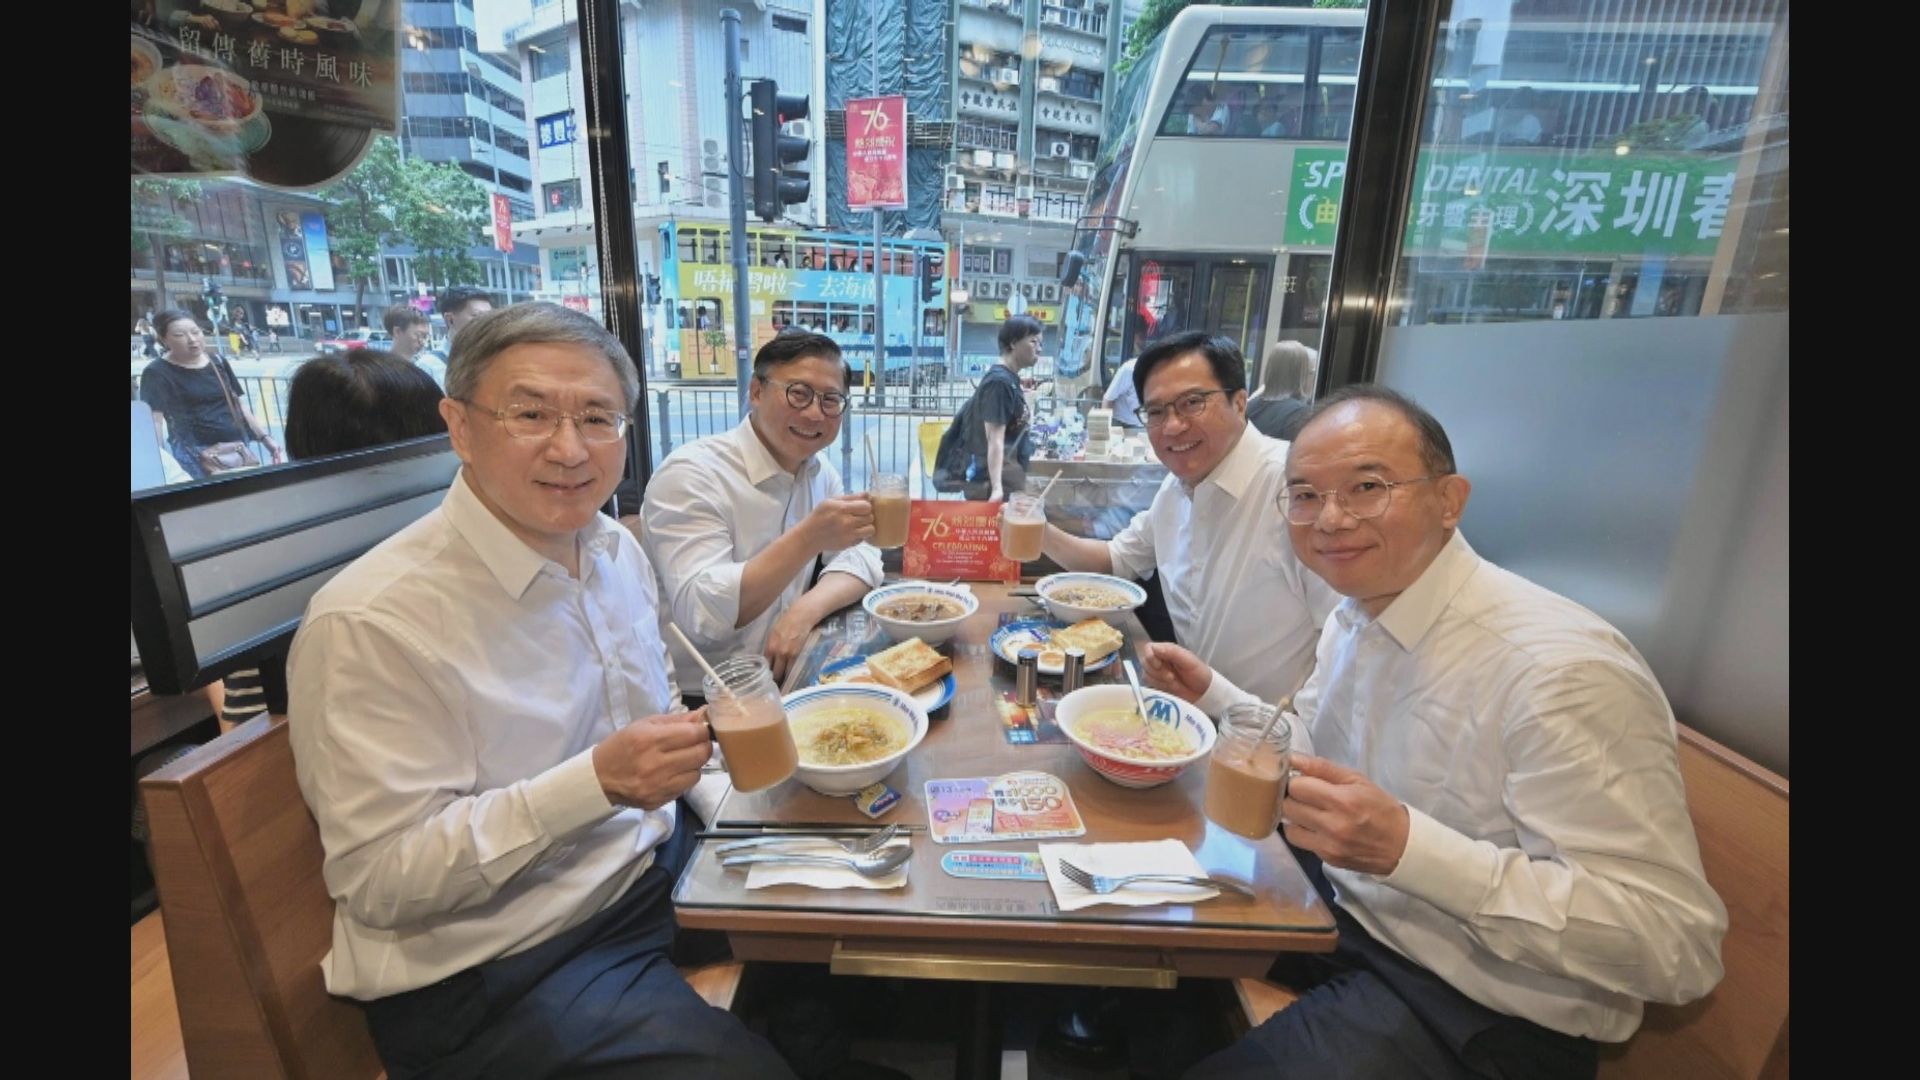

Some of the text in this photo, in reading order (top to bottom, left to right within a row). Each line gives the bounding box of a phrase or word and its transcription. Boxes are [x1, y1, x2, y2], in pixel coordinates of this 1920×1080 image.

[179, 26, 373, 89] 留傳舊時風味
[861, 102, 889, 135] 76
[1424, 164, 1539, 195] DENTAL
[920, 512, 950, 541] 76
[932, 542, 988, 552] CELEBRATING
